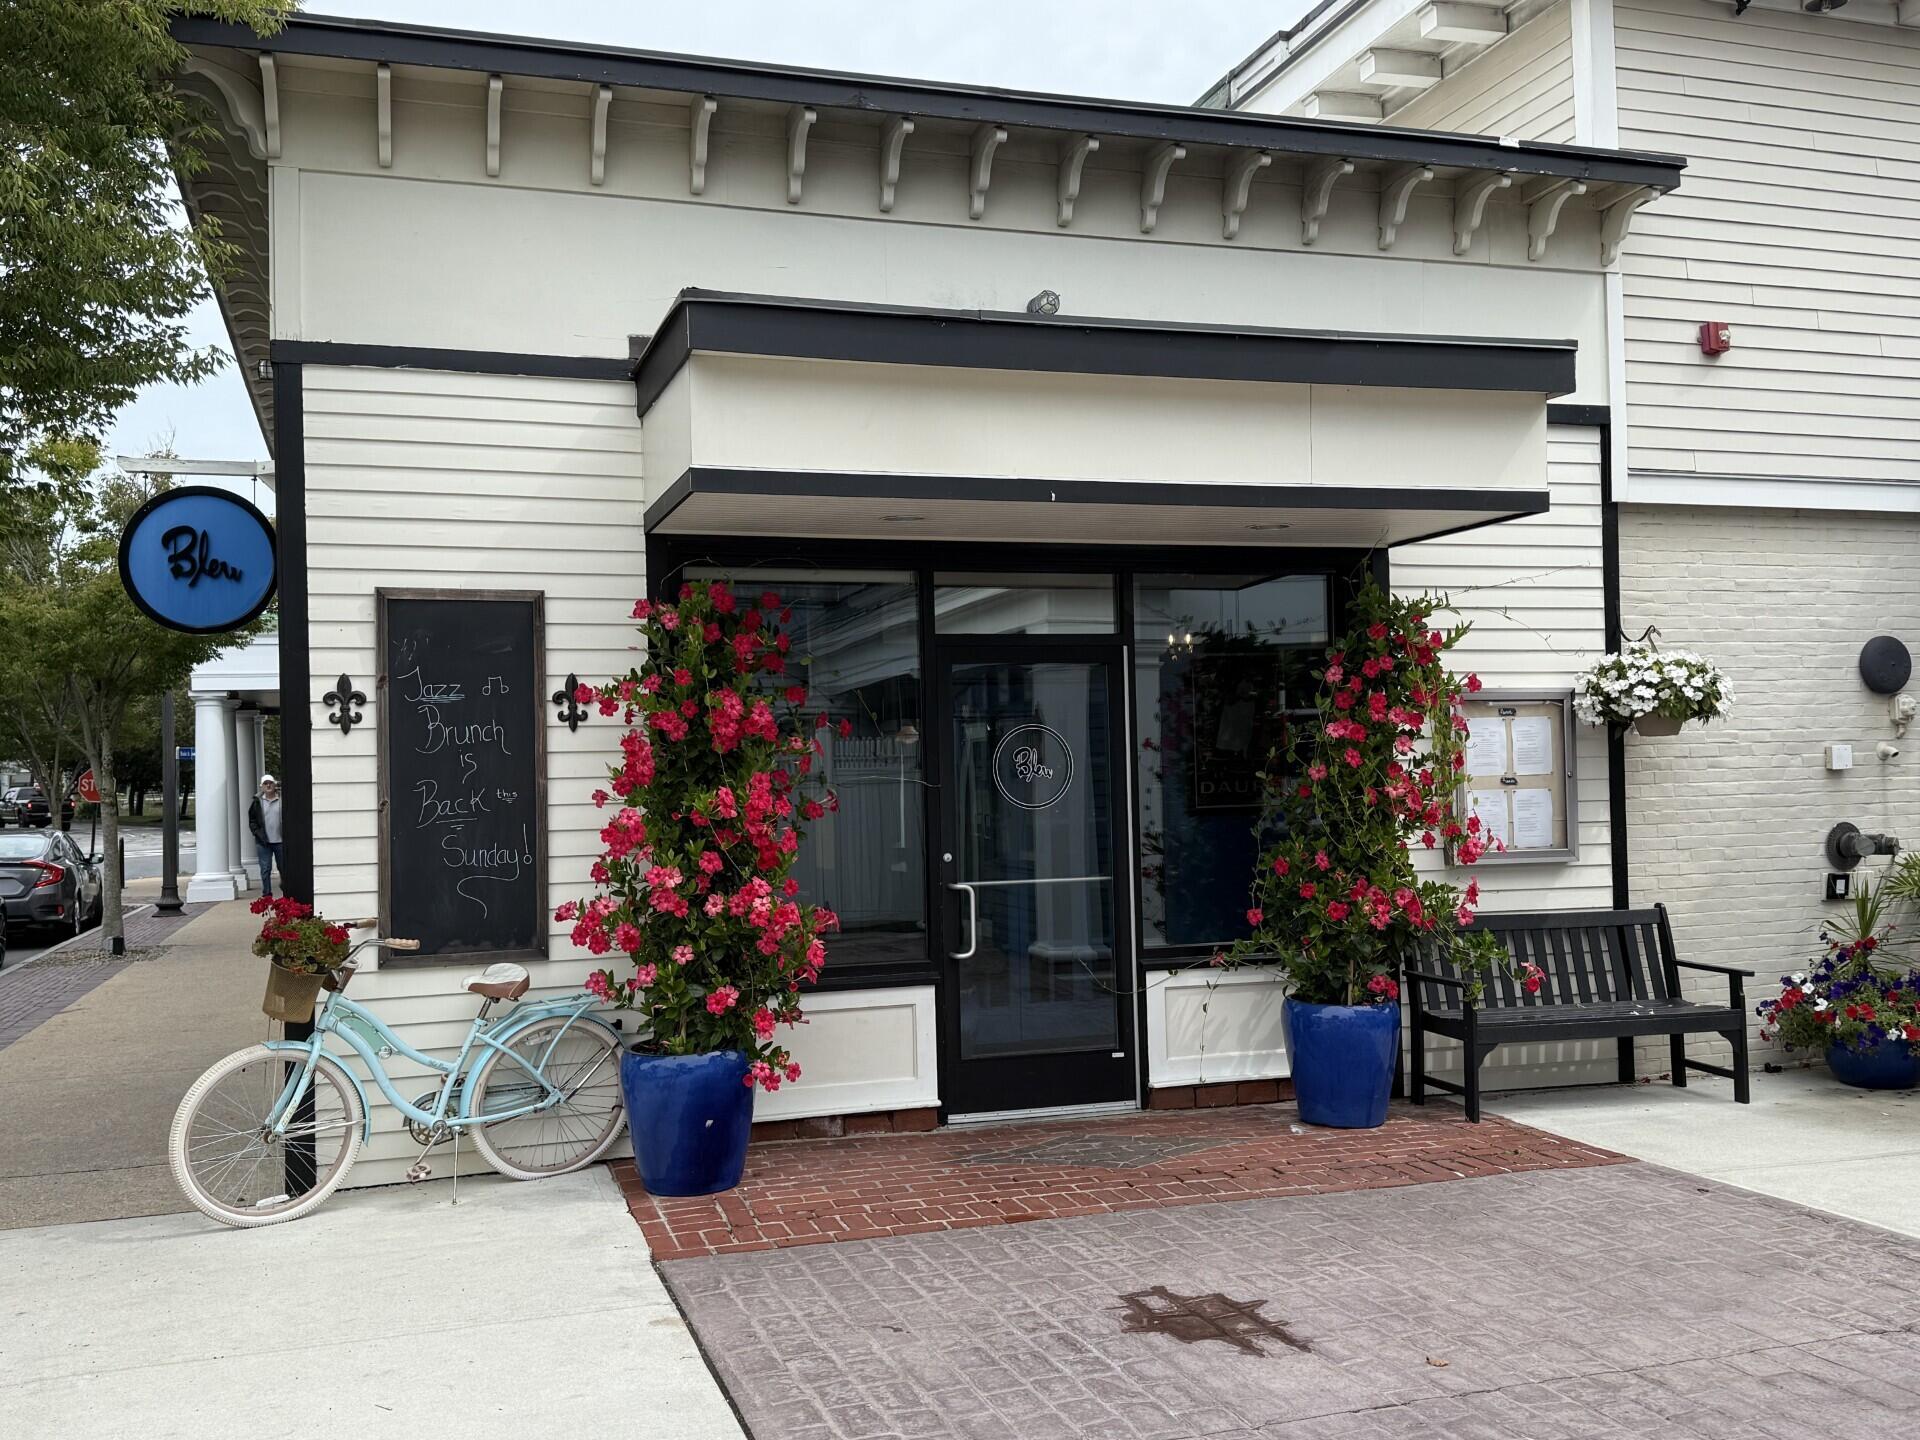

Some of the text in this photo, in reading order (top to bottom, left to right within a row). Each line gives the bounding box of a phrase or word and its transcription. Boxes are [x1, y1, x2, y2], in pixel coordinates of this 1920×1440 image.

[397, 666, 464, 702] Jazz
[416, 704, 511, 755] Brunch
[81, 778, 97, 792] ST
[412, 779, 519, 828] Back this
[442, 823, 533, 881] Sunday!
